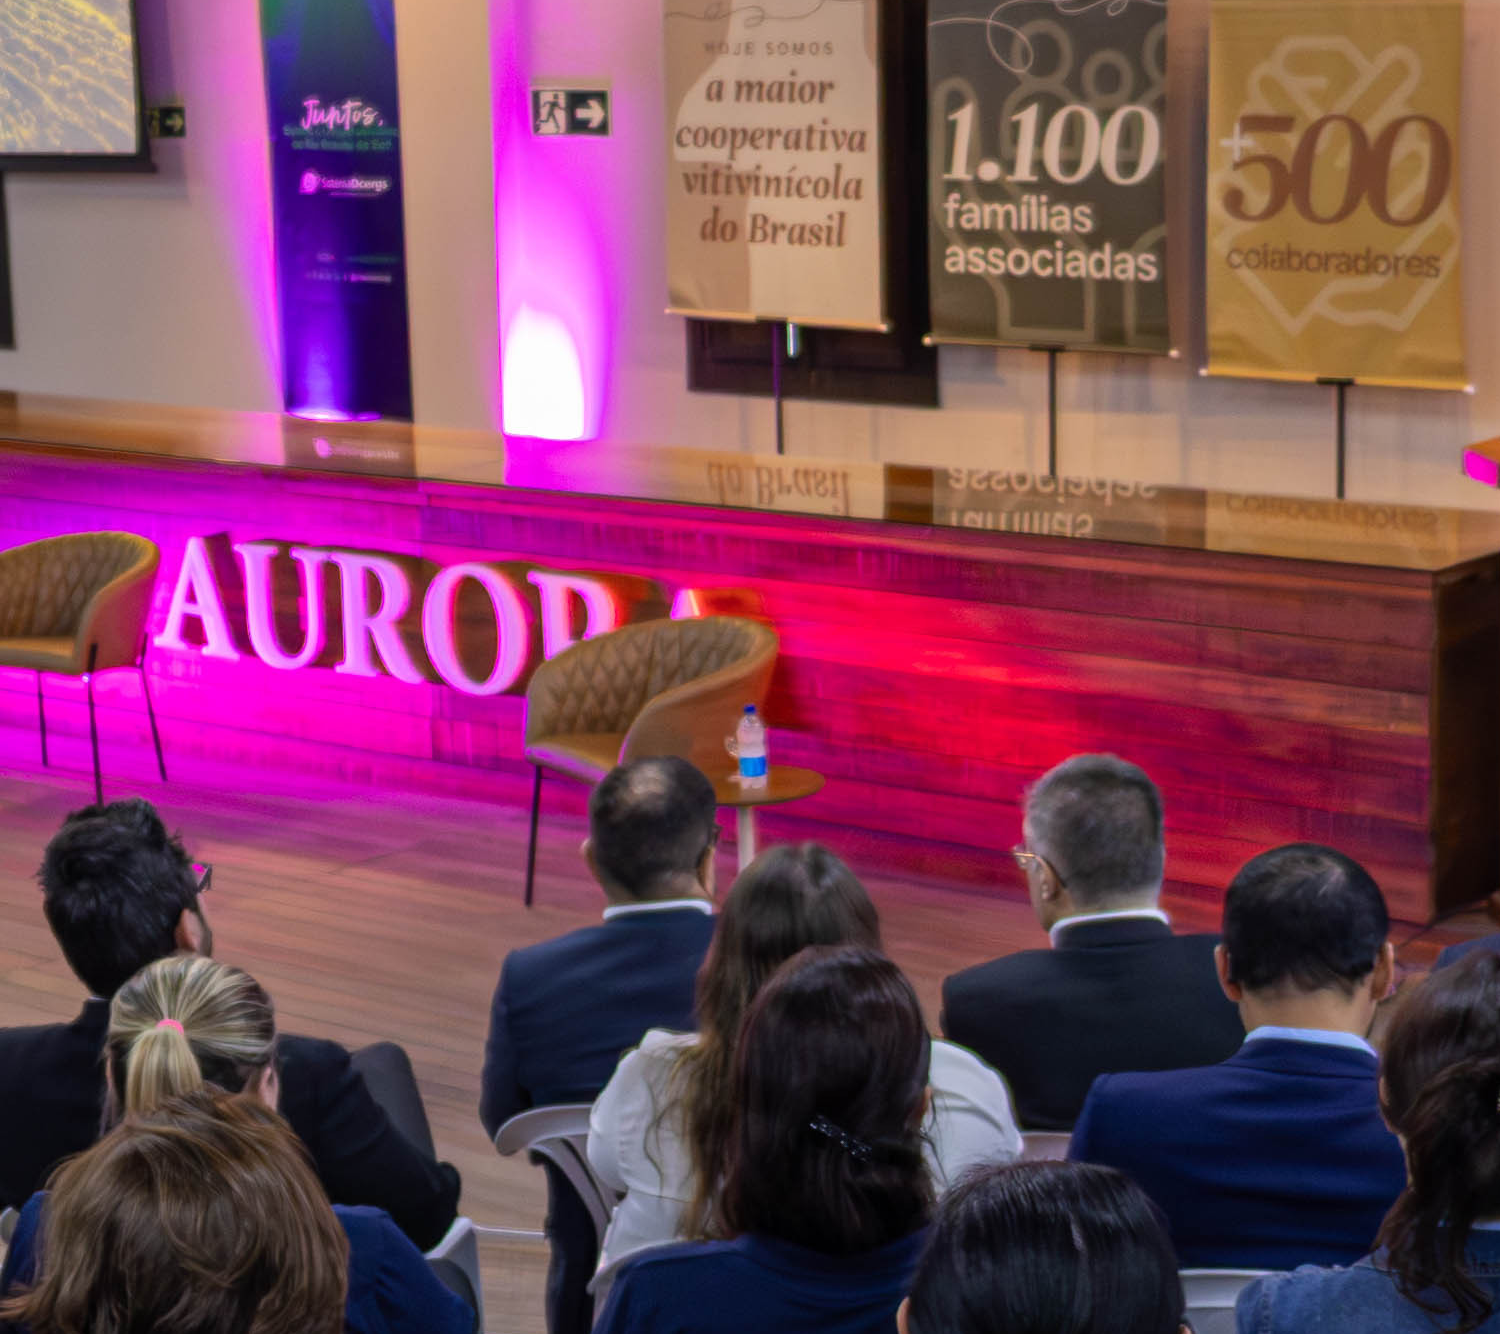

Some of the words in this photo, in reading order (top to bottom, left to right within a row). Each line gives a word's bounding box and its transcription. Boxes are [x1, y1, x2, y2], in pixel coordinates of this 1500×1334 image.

[765, 41, 834, 56] SOMOS
[705, 78, 724, 103] a
[733, 69, 835, 104] maior
[675, 117, 868, 161] cooperativa
[943, 101, 1160, 186] 1.100
[681, 163, 864, 201] vitivinícola
[700, 205, 738, 243] do
[749, 211, 847, 248] Brasil
[943, 193, 1094, 234] famílias
[944, 240, 1158, 282] associadas
[1226, 243, 1442, 278] colaboradores
[154, 536, 702, 697] AUROR
